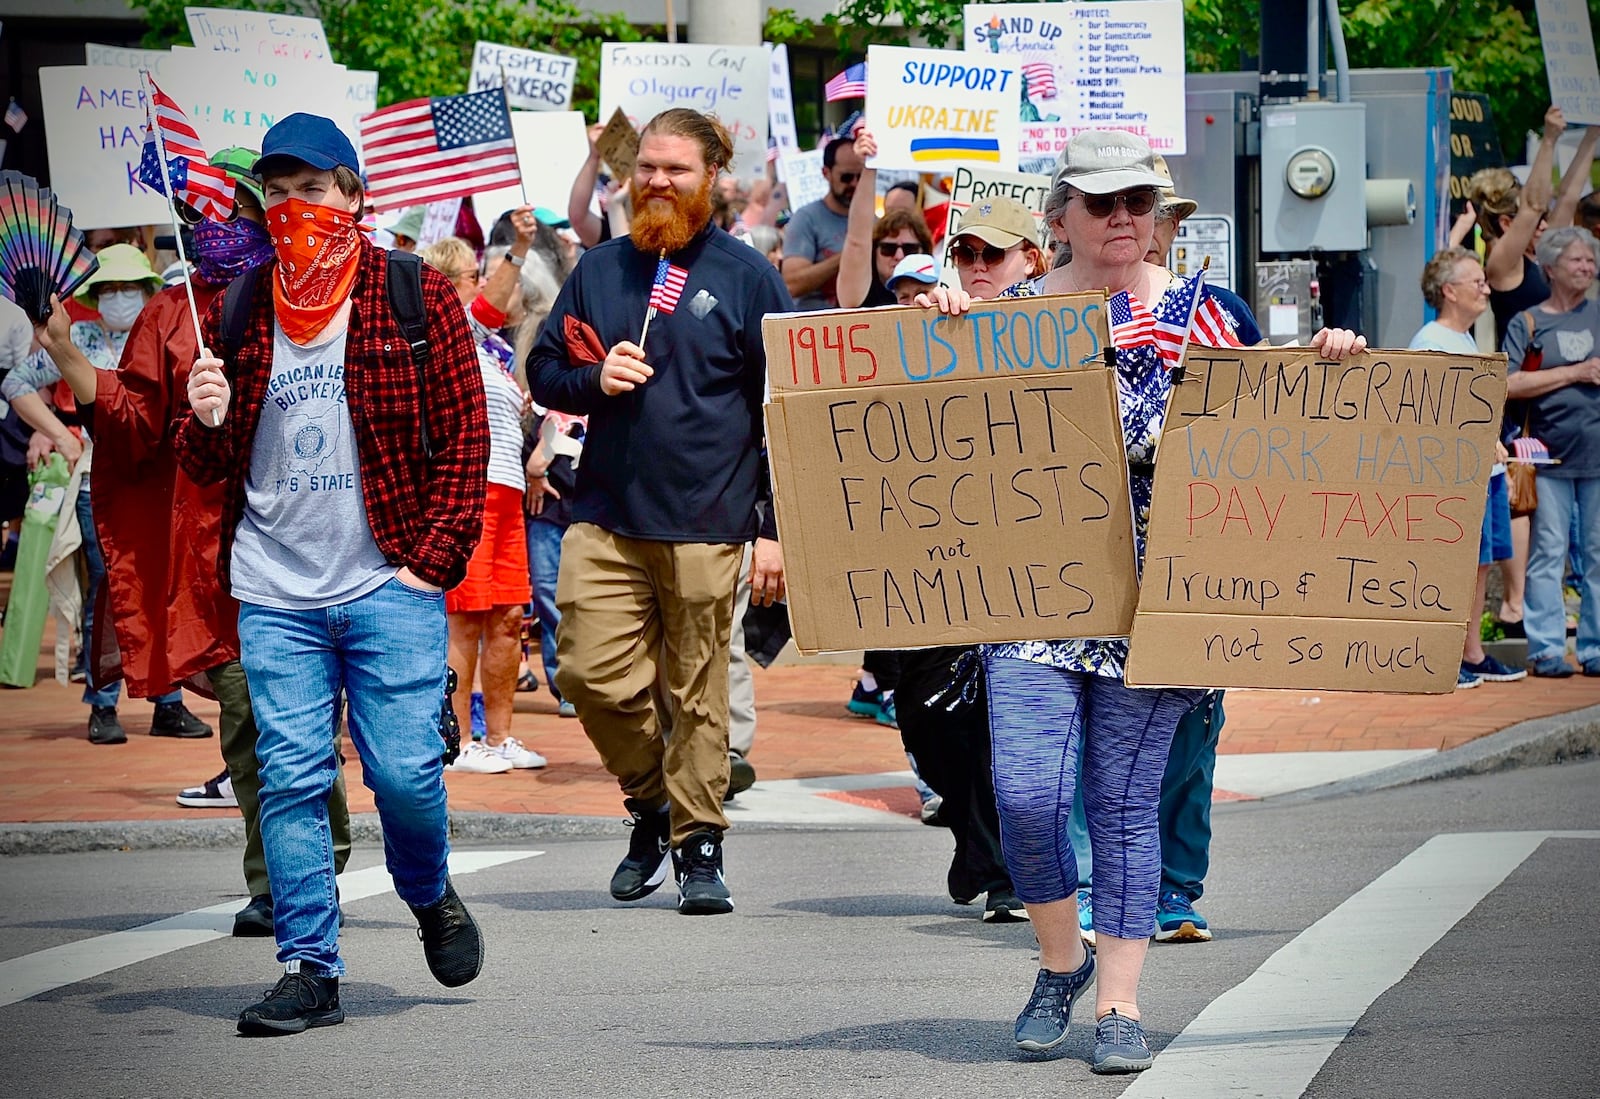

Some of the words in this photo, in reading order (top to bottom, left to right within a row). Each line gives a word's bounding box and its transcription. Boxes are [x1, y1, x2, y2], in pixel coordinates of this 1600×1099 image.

[1039, 21, 1062, 41] UP
[1088, 21, 1101, 29] Our
[1104, 21, 1147, 31] Democracy
[1088, 32, 1101, 40] Our
[1104, 32, 1152, 40] Constitution
[1088, 43, 1101, 51] Our
[1104, 43, 1129, 53] Rights
[1088, 55, 1102, 63] Our
[1104, 54, 1140, 64] Diversity
[479, 46, 571, 78] RESPECT
[1089, 66, 1102, 74] Our
[1105, 66, 1137, 74] National
[1139, 65, 1162, 73] Parks
[243, 69, 278, 88] NO
[902, 61, 1014, 92] SUPPORT
[1076, 79, 1102, 87] HANDS
[628, 76, 743, 110] Oligargle
[1089, 90, 1125, 98] Medicare
[1089, 101, 1124, 109] Medicaid
[887, 104, 1000, 133] UKRAINE
[1089, 112, 1113, 120] Social
[1115, 112, 1148, 121] Security
[1054, 127, 1067, 138] TO
[1036, 141, 1050, 152] NO
[1097, 146, 1120, 157] MOM
[953, 167, 1050, 212] PROTECT
[787, 323, 878, 385] 1945
[896, 314, 958, 381] US
[962, 304, 1100, 373] TROOPS
[275, 382, 348, 412] BUCKEYE
[1180, 357, 1497, 430] IMMIGRANTS
[829, 386, 1073, 463] FOUGHT
[1187, 425, 1331, 483] WORK
[1355, 432, 1481, 486] HARD
[310, 473, 354, 492] STATE
[840, 462, 1110, 532] FASCISTS
[1185, 482, 1286, 541] PAY
[1311, 491, 1467, 543] TAXES
[926, 537, 971, 561] not
[846, 562, 1094, 628] FAMILIES
[1155, 555, 1280, 611] Trump
[1336, 557, 1452, 611] Tesla
[1203, 628, 1264, 664] not
[1287, 636, 1324, 665] so
[1345, 636, 1435, 675] much
